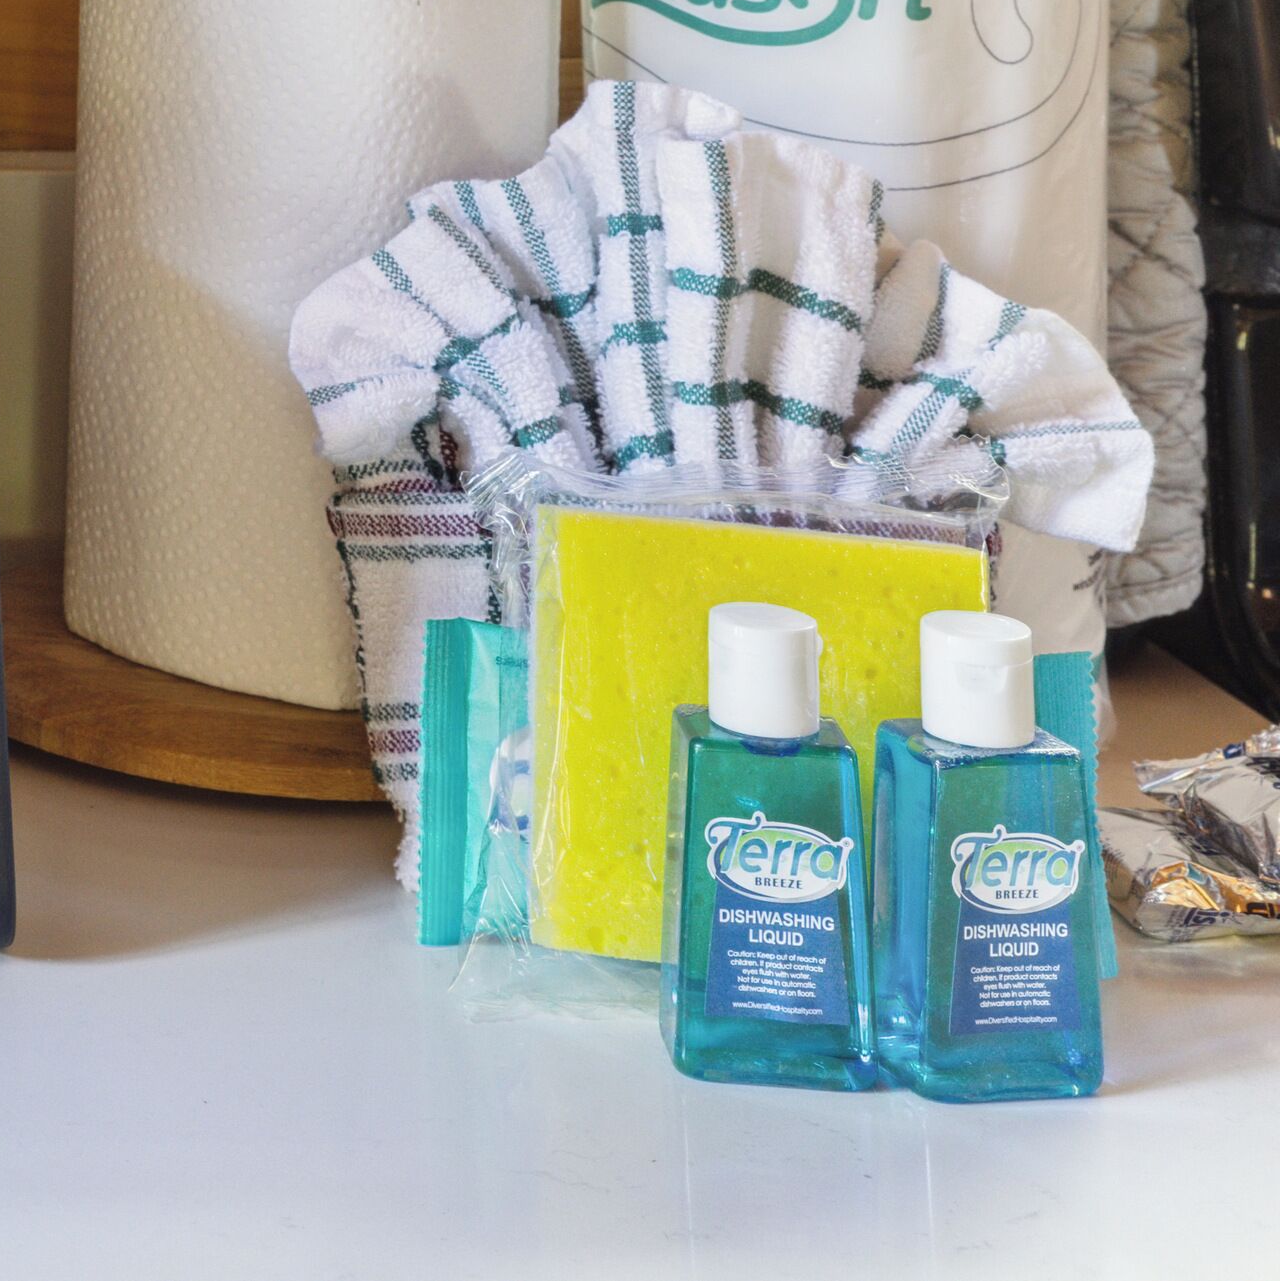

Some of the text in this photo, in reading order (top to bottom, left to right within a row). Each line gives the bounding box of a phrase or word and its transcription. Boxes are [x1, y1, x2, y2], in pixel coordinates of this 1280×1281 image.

[708, 816, 844, 880] Terra
[954, 828, 1076, 887] Terra
[755, 877, 803, 890] BREEZE
[996, 889, 1039, 899] BREEZE
[719, 909, 835, 931] DISHWASHING
[749, 929, 804, 946] LIQUID
[964, 923, 1068, 940] DISHWASHING
[990, 942, 1039, 957] LIQUID
